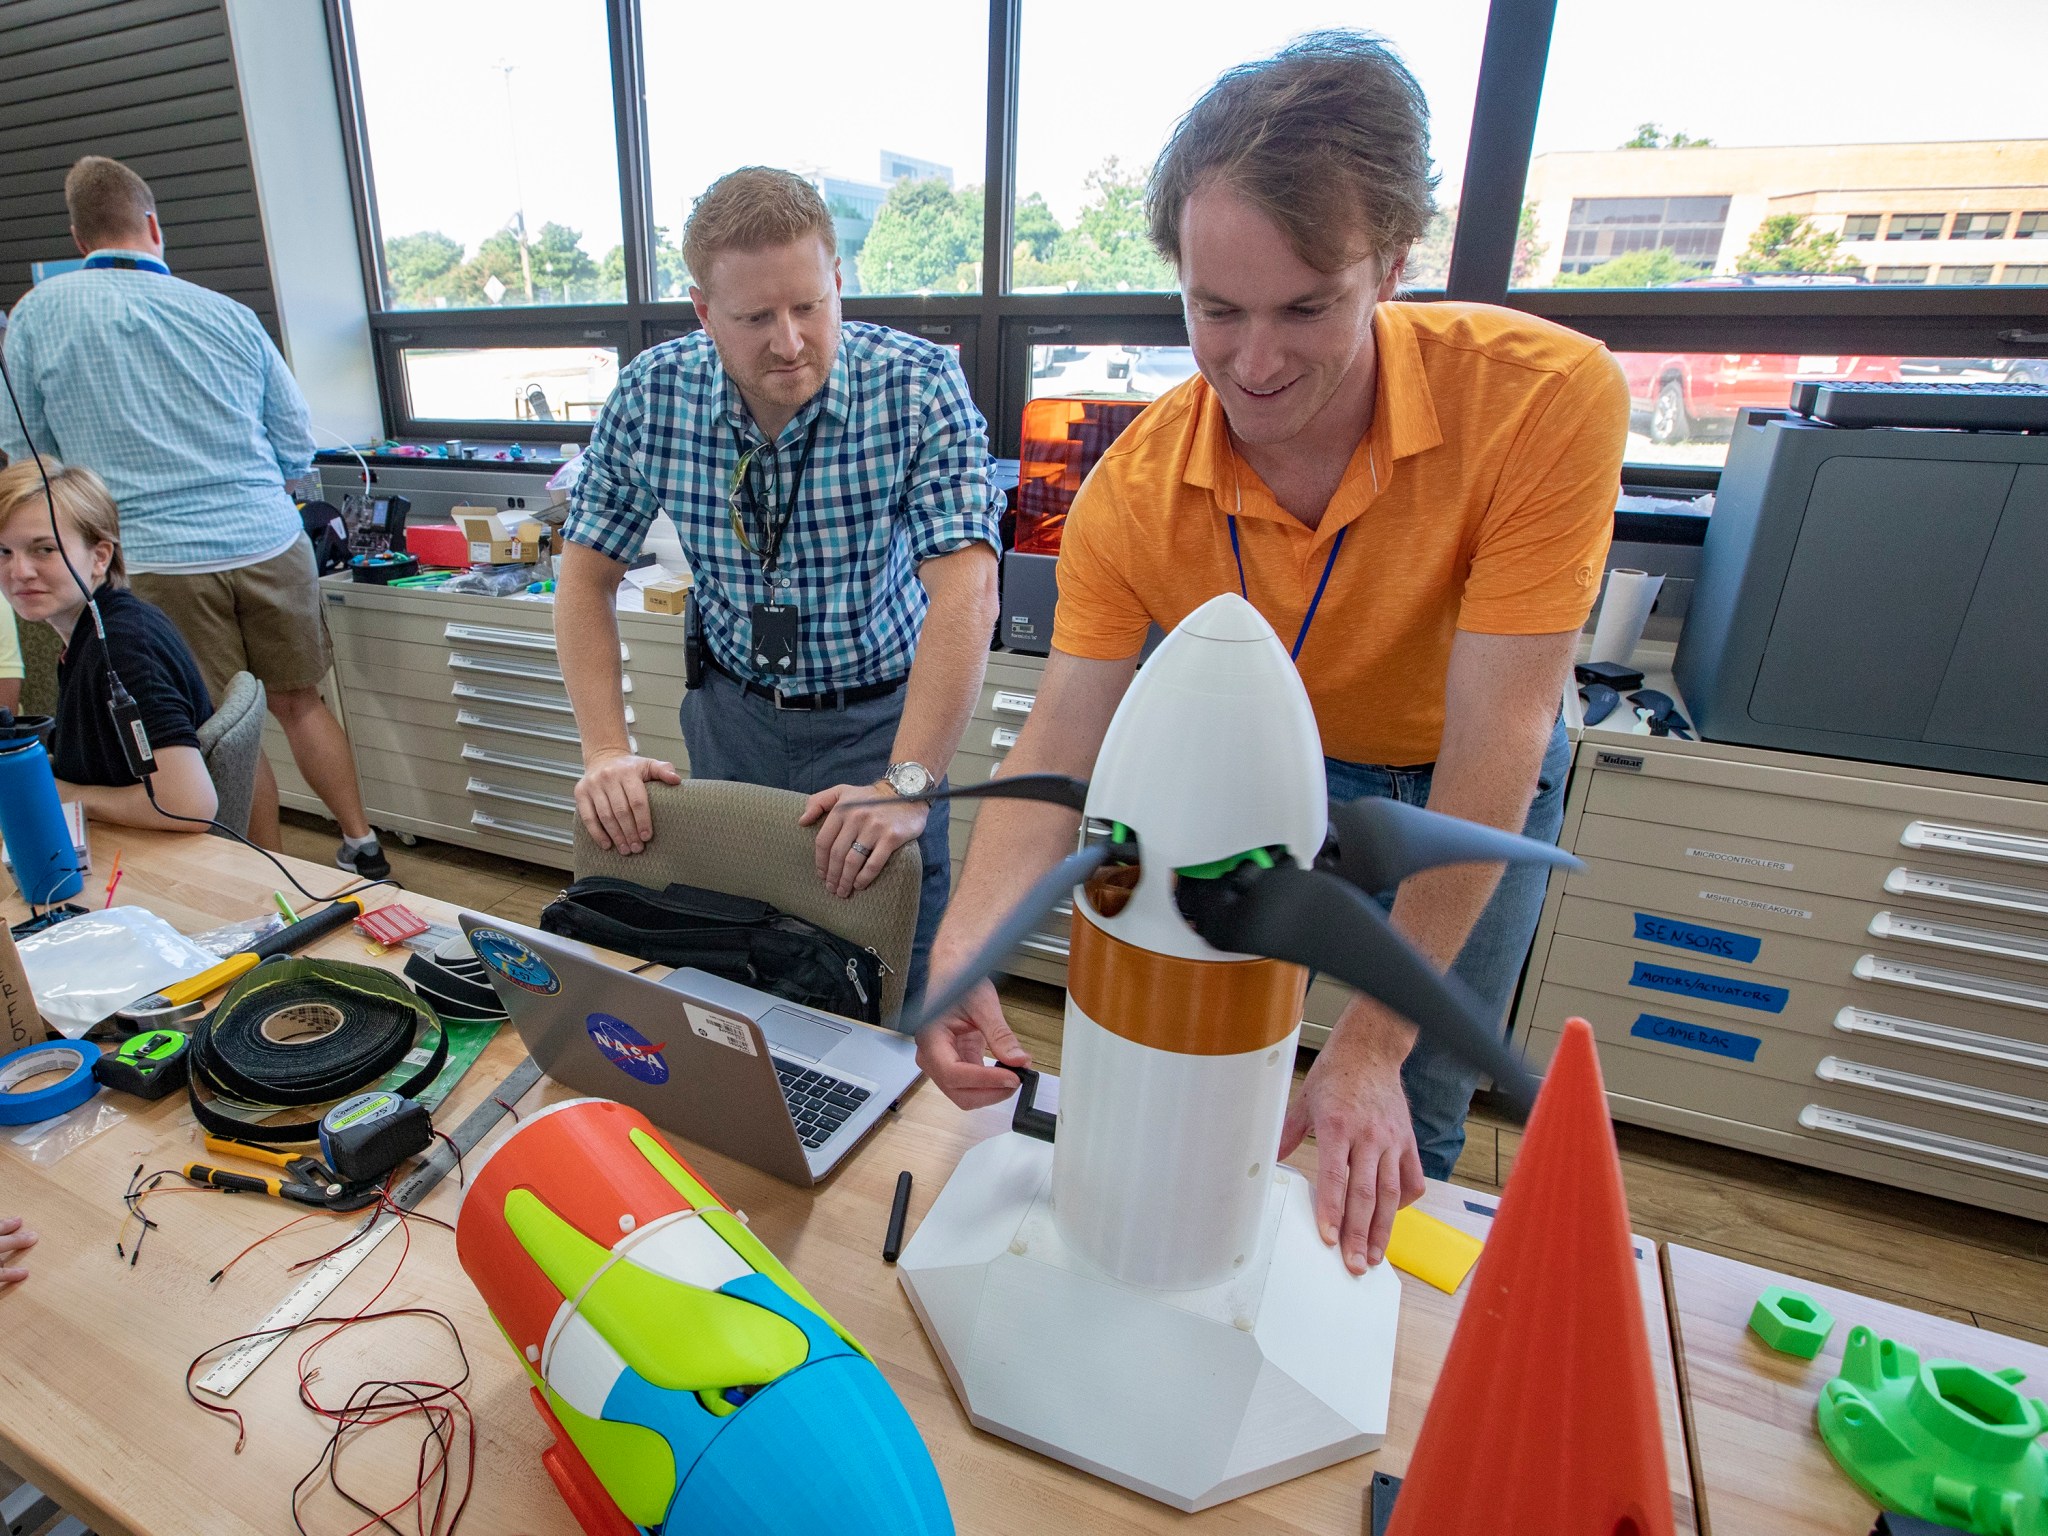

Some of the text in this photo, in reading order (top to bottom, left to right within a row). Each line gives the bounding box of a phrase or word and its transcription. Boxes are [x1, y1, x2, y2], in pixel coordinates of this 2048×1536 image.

[1601, 754, 1643, 768] Vidmar
[1692, 849, 1786, 870] MICROCONTROLLERS
[1705, 893, 1804, 917] MSHIELDS/BREAKOUTS
[473, 930, 541, 963] SCEPTOR
[1642, 921, 1734, 955] SENSORS
[1639, 971, 1772, 1003] MOTORS/ACTUATORS
[1652, 1021, 1730, 1049] CAMERAS
[592, 1030, 666, 1072] NASA
